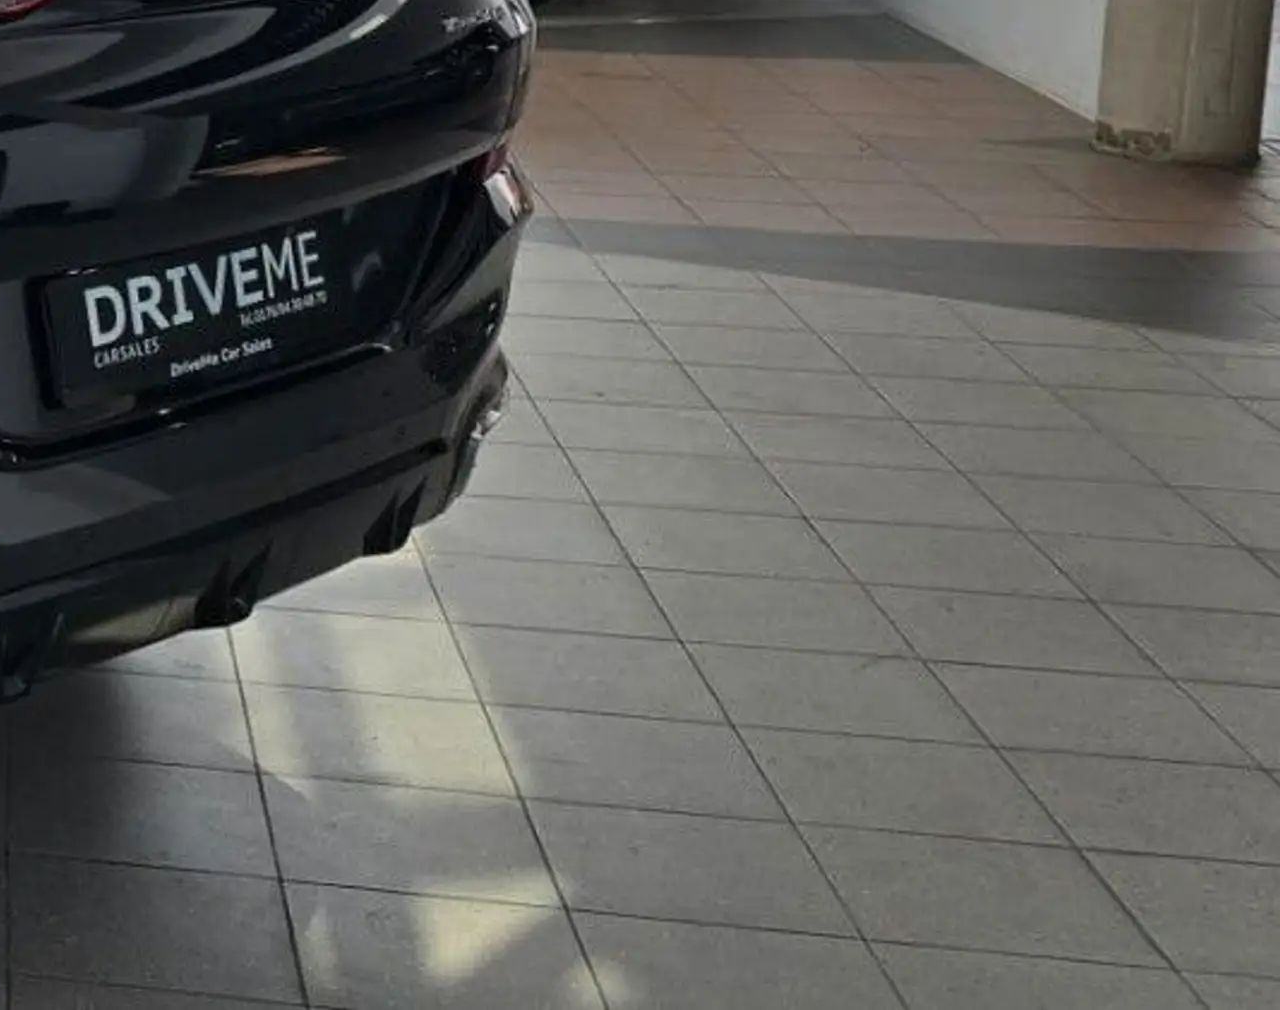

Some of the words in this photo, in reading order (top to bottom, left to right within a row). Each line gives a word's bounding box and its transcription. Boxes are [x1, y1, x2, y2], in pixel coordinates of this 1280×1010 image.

[84, 230, 326, 347] DRIVEME
[93, 336, 160, 369] CARSALES
[220, 346, 241, 363] Car
